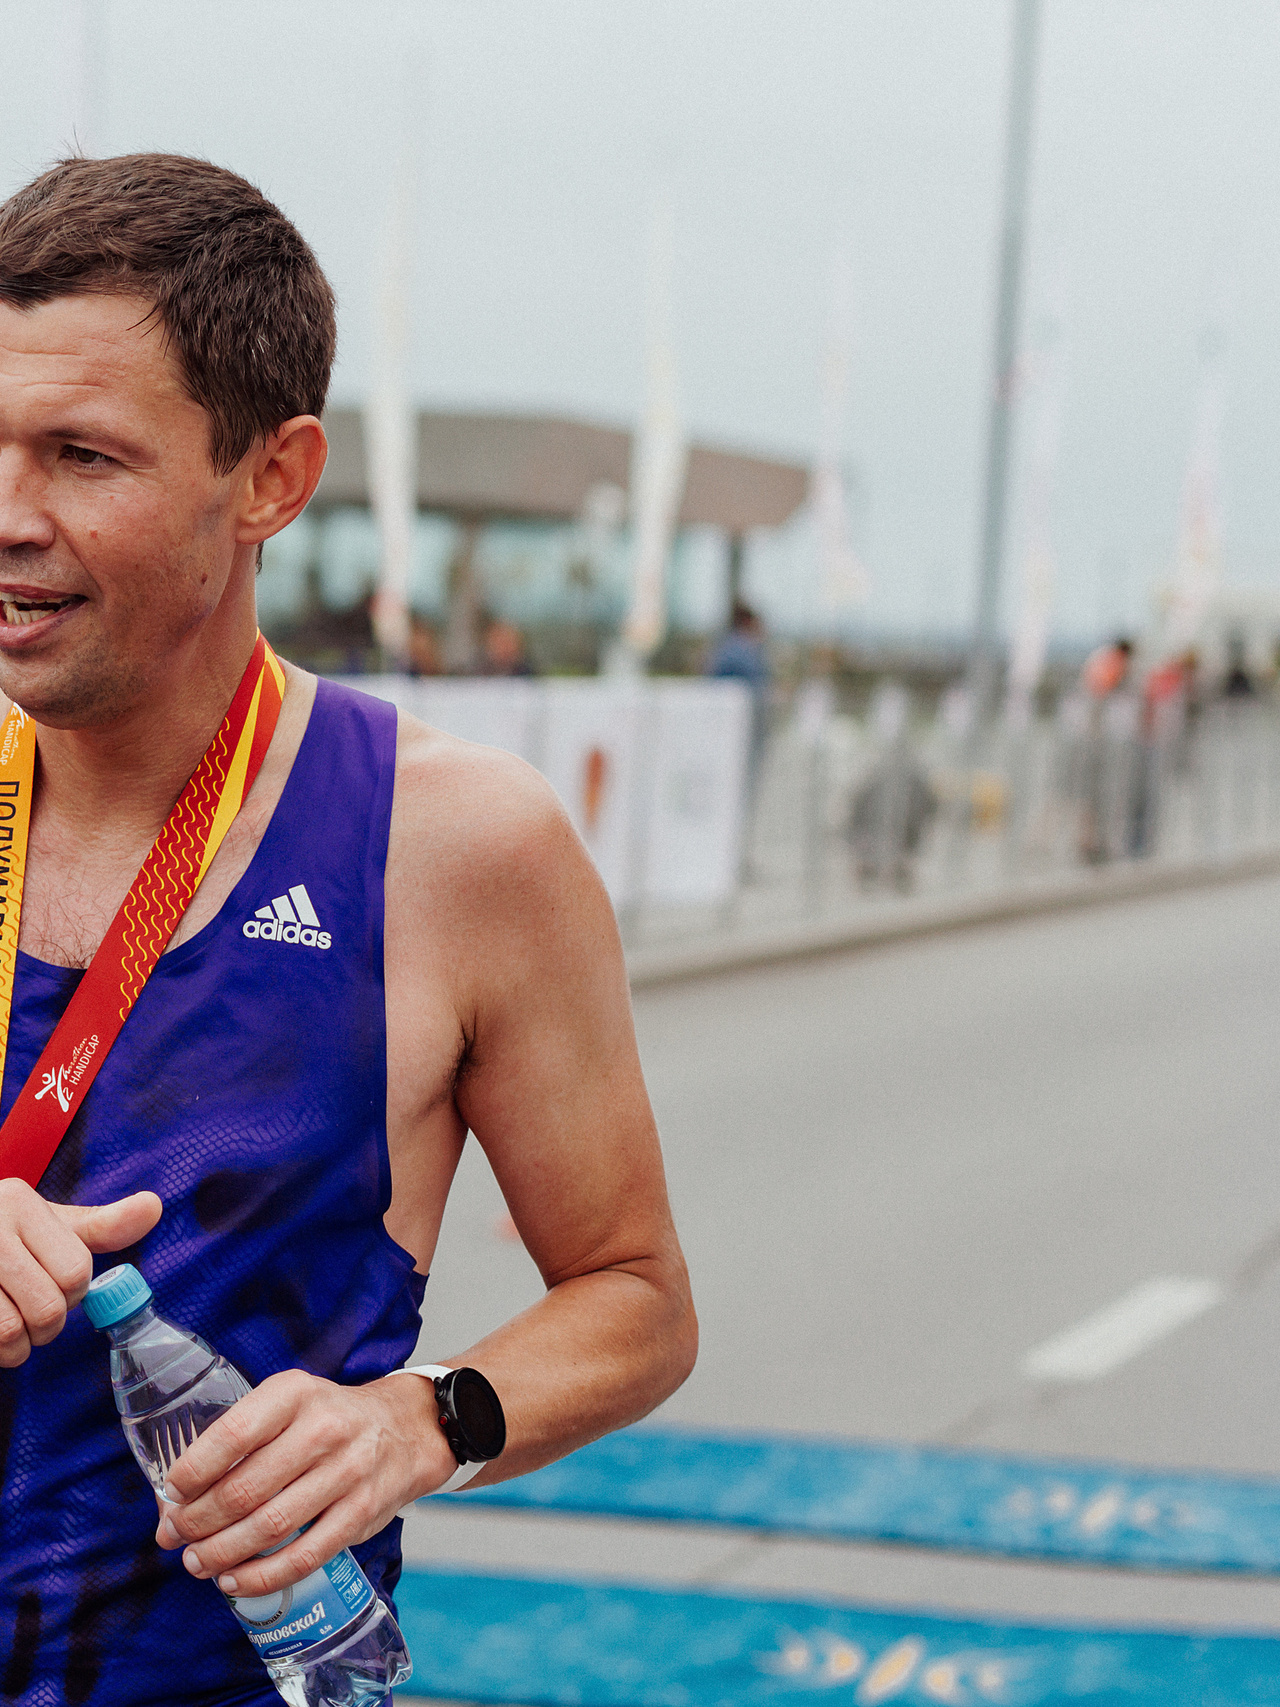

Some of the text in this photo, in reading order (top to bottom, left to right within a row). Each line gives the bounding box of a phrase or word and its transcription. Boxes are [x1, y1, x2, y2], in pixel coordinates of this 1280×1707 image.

[0, 720, 15, 766] HANDICAP
[242, 918, 332, 950] adidas
[69, 1034, 100, 1085] HANDICAP
